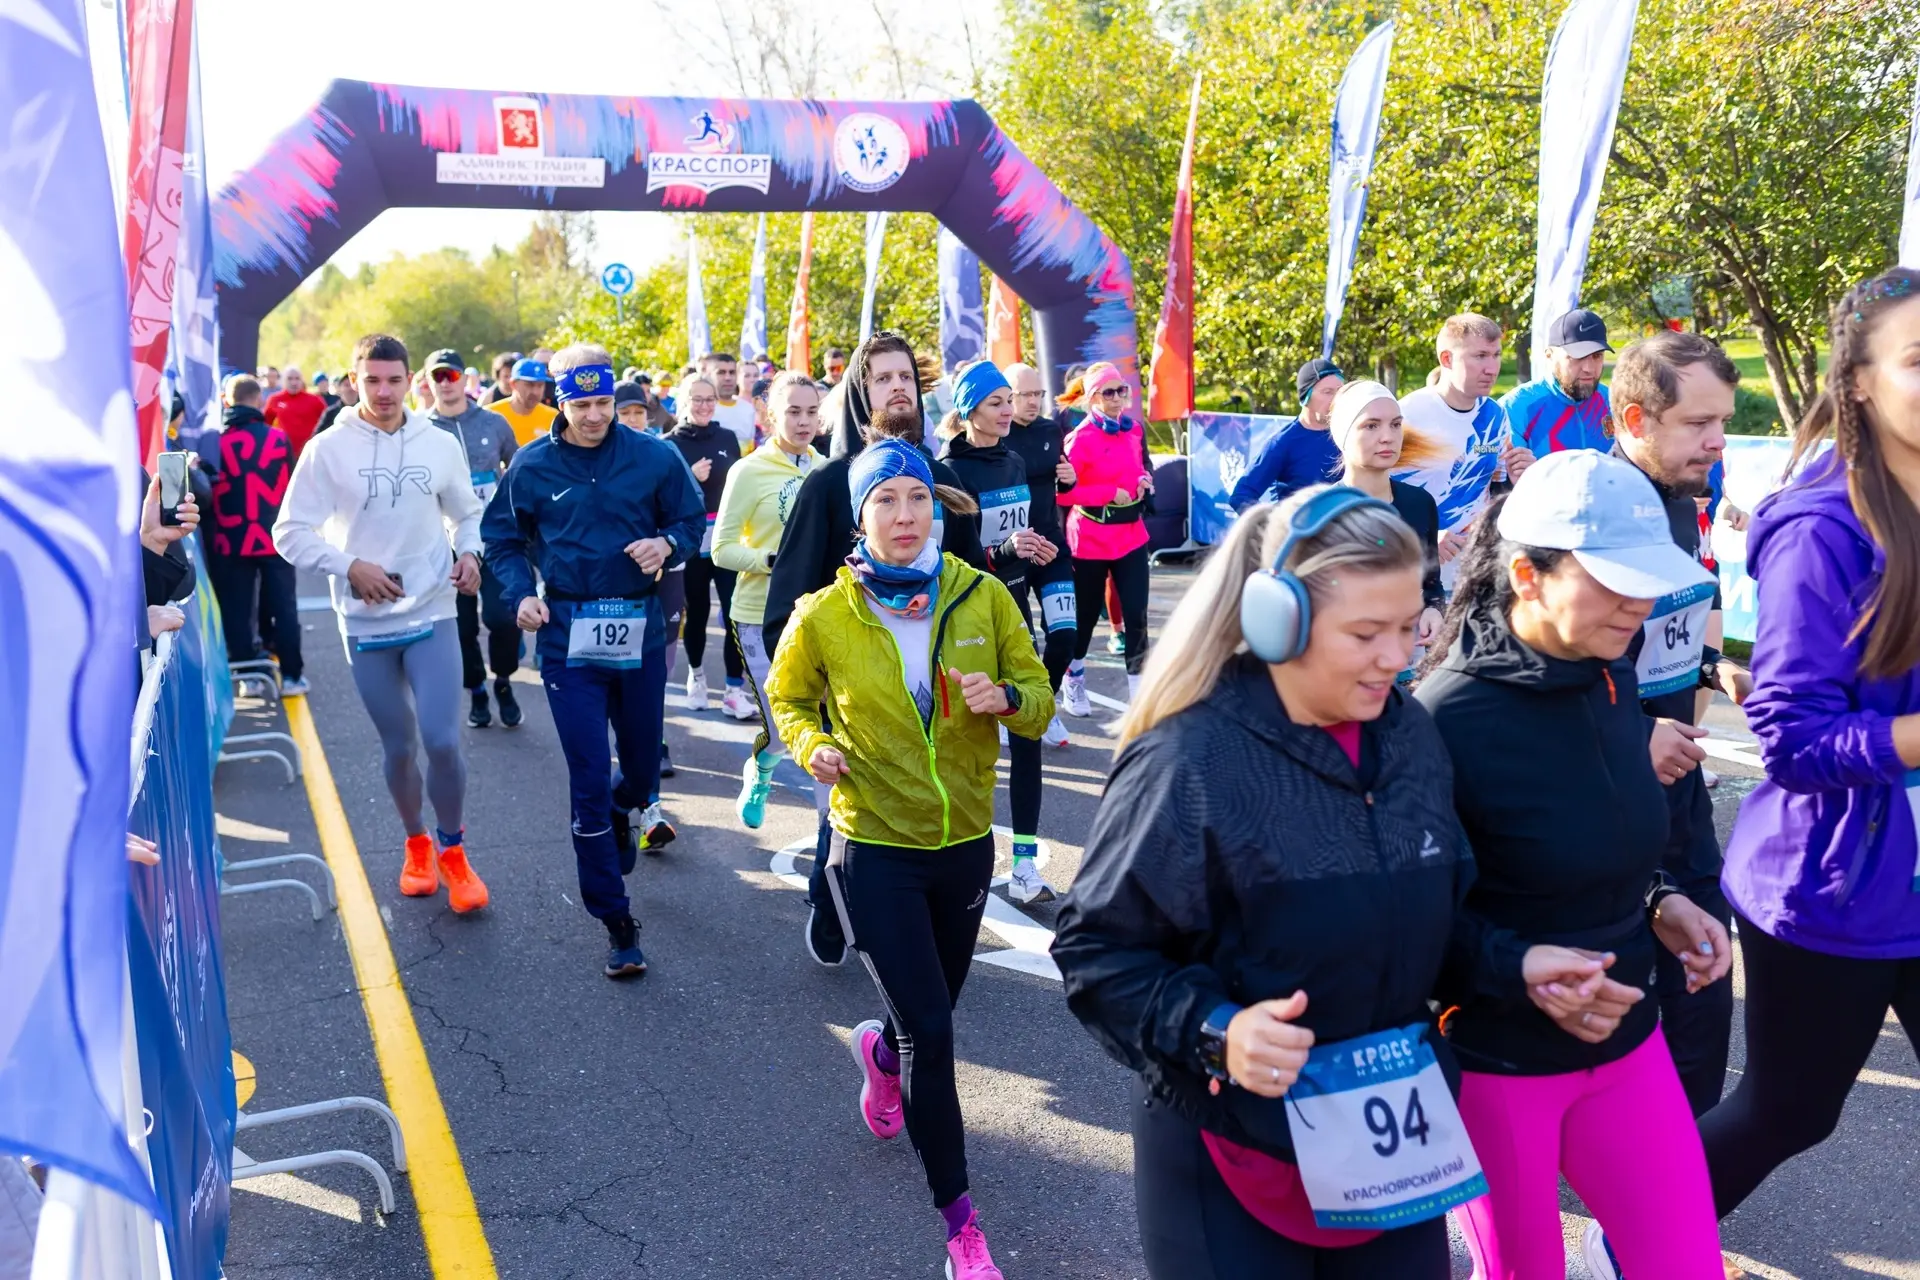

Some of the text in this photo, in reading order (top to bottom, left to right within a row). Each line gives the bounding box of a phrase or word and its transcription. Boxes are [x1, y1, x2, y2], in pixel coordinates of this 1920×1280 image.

[438, 169, 495, 182] ГОРОДА
[456, 157, 587, 172] АДМИНИСТРАЦИЯ
[652, 157, 768, 173] КРАССПОРТ
[359, 465, 432, 498] TYR
[999, 506, 1027, 532] 210
[592, 623, 630, 646] 192
[1664, 611, 1690, 651] 64
[1352, 1037, 1412, 1069] КРОСС
[1363, 1086, 1430, 1158] 94
[1343, 1165, 1443, 1202] КРАСНОЯРСКИЙ
[1441, 1154, 1466, 1178] КРАЙ
